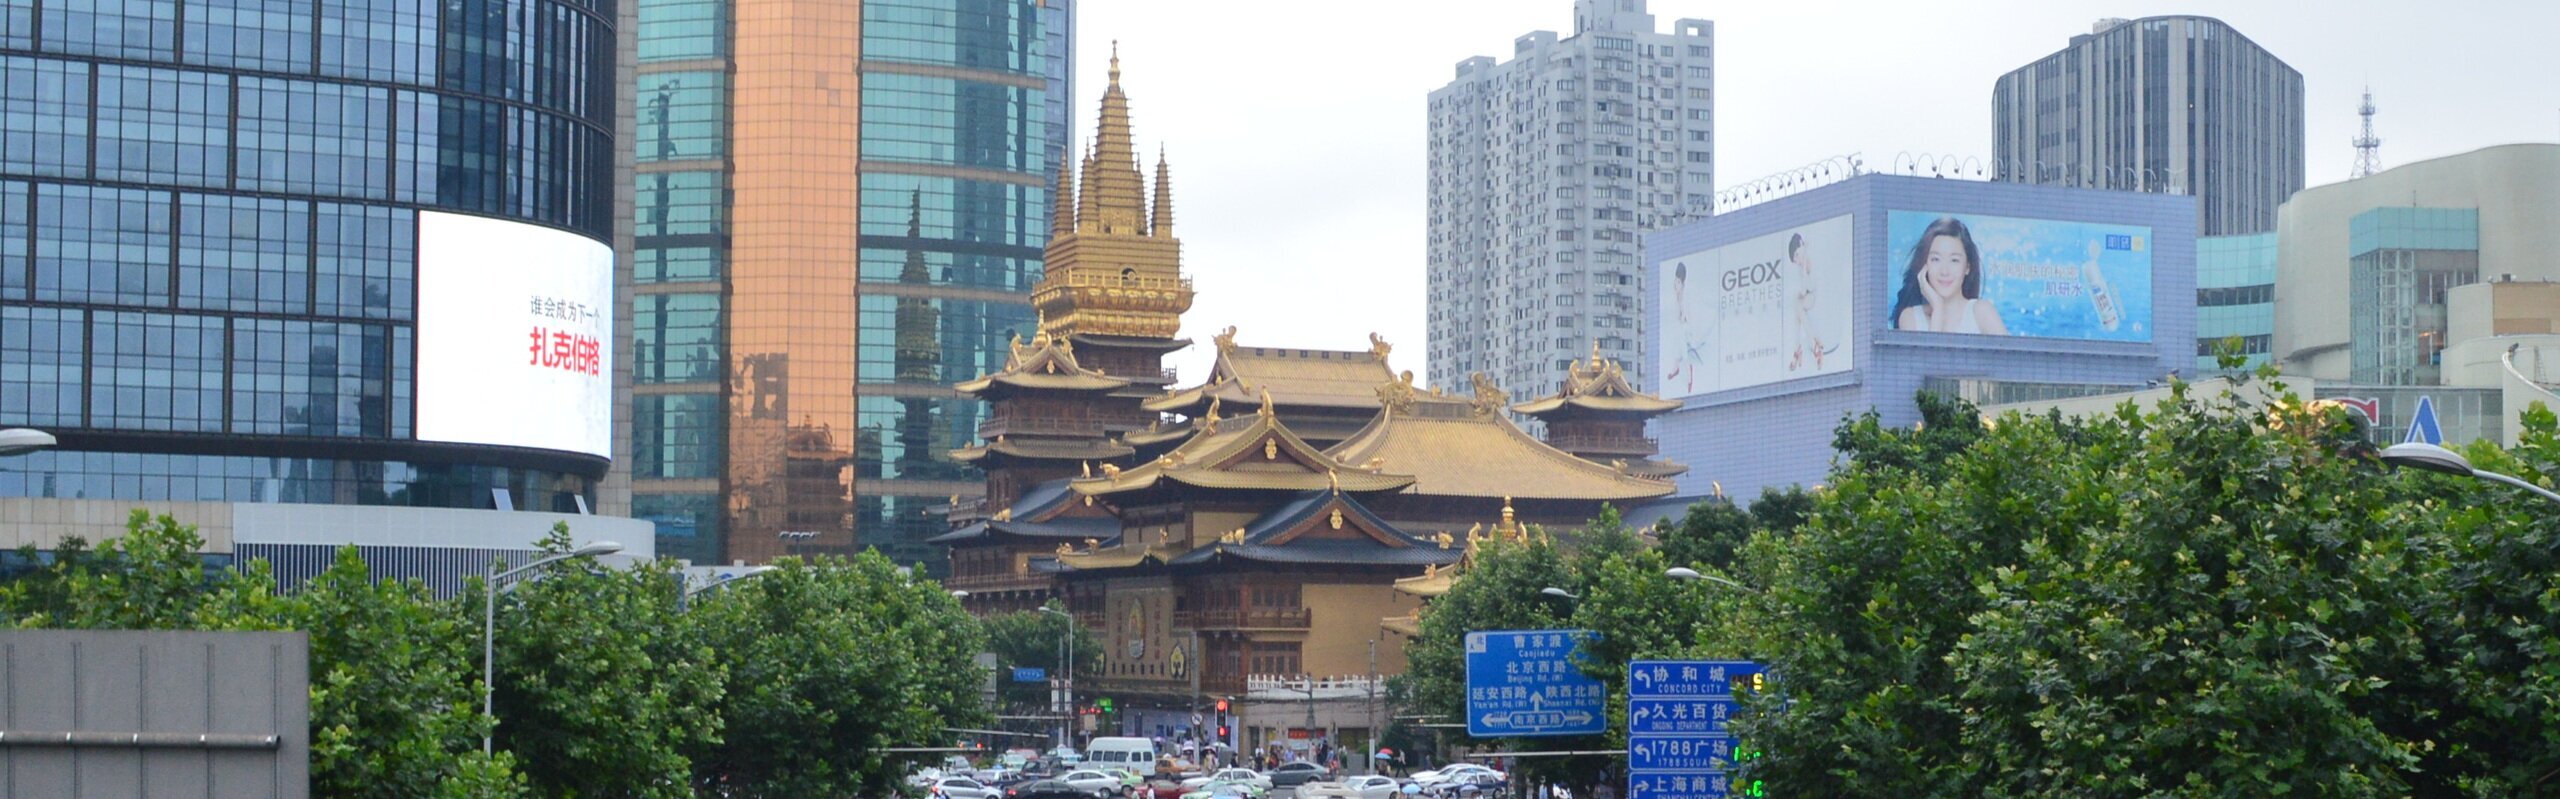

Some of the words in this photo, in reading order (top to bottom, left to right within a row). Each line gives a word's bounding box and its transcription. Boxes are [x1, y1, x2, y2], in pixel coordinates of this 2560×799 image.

[1721, 259, 1781, 292] GEOX
[1720, 283, 1782, 310] BREATHES
[531, 295, 600, 329] 谁会成为下一个
[529, 326, 599, 377] 扎克伯格
[1518, 649, 1556, 659] Caojiadu
[1506, 661, 1566, 674] 北京西路
[1507, 674, 1533, 684] Beijing
[1472, 686, 1527, 701] 延安西路
[1545, 684, 1600, 699] 陕西北路
[1658, 684, 1698, 694] CONCORD
[1701, 684, 1721, 694] CITY
[1652, 703, 1728, 719] 久光百货
[1652, 740, 1728, 756] 1788广场
[1652, 775, 1727, 792] 上海商城
